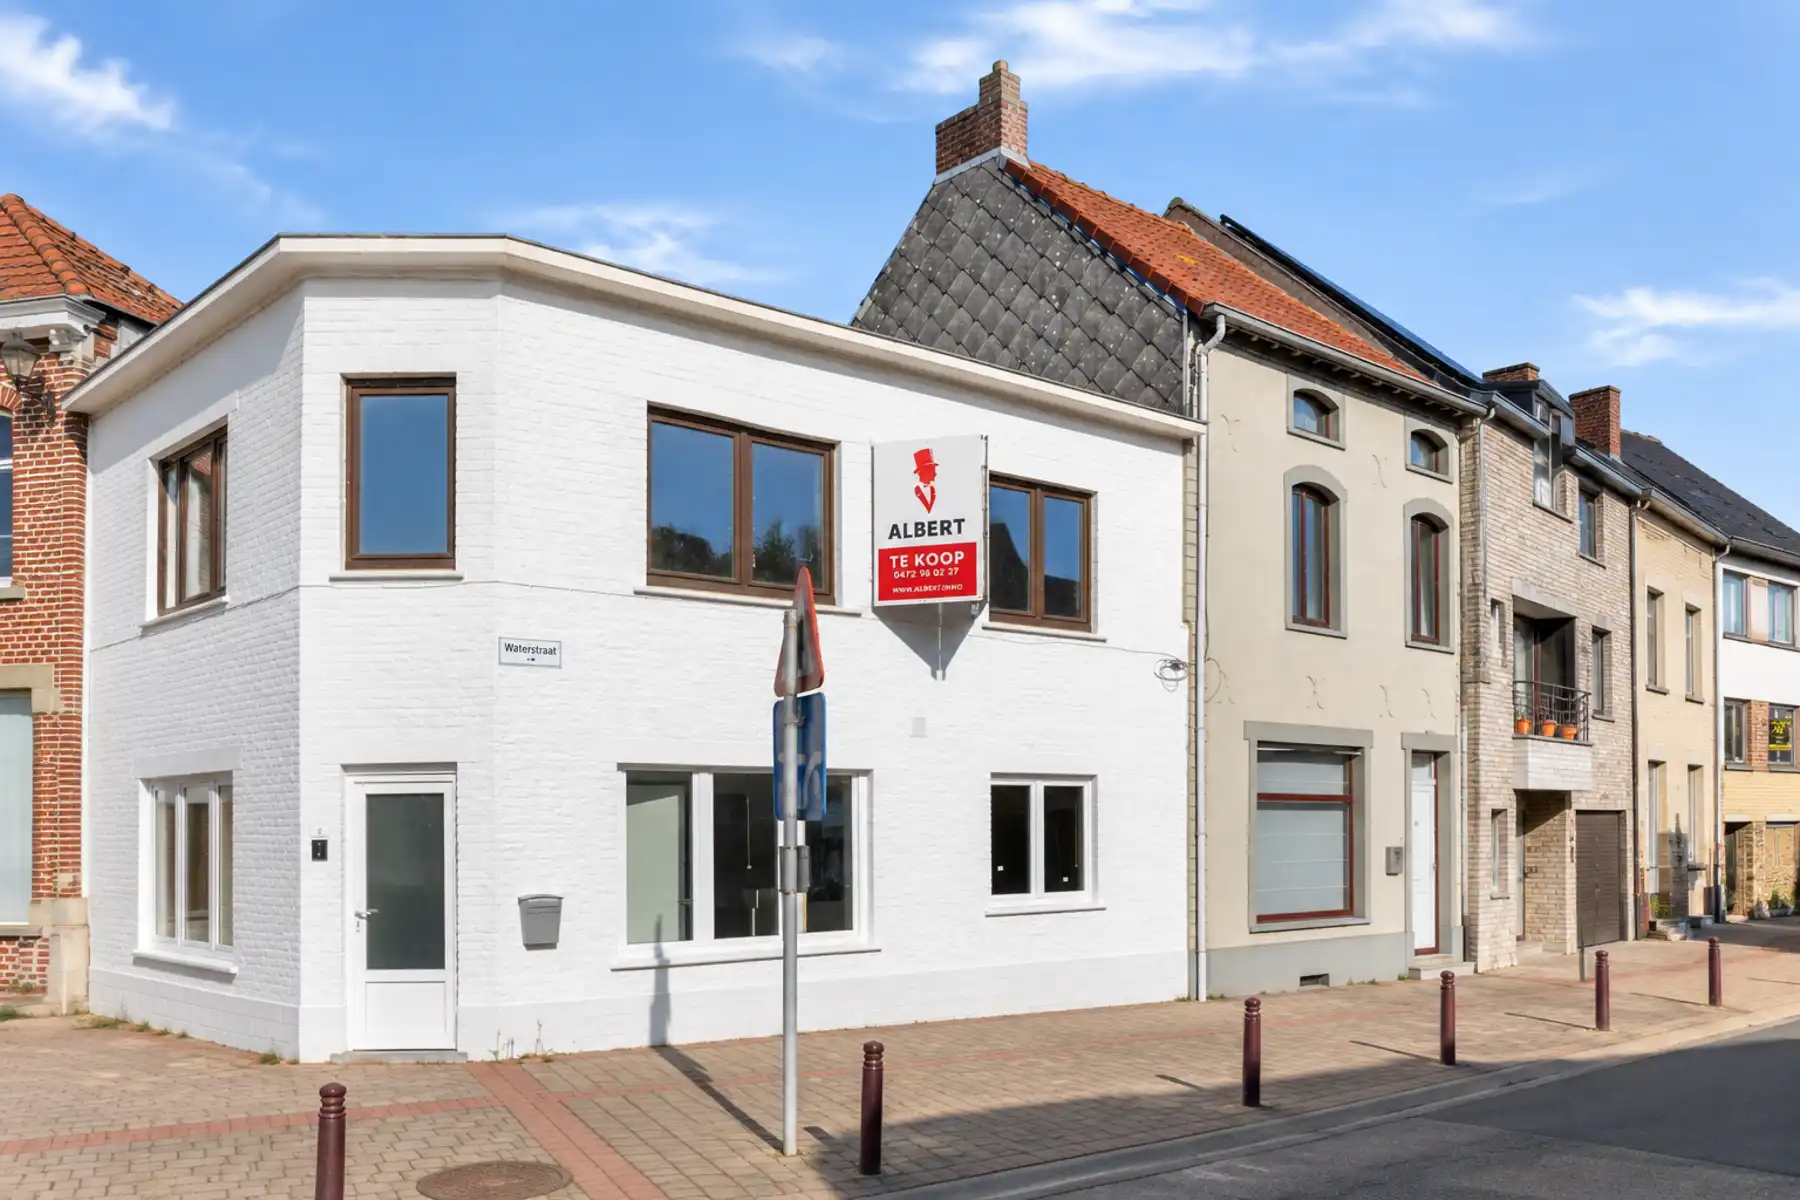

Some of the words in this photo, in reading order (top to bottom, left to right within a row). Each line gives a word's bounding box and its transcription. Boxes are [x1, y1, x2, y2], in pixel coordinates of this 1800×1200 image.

[888, 518, 965, 540] ALBERT
[889, 555, 909, 568] TE
[914, 551, 965, 567] KOOP
[893, 570, 917, 579] 0472
[933, 567, 945, 577] 02
[947, 567, 959, 576] 27
[504, 642, 557, 655] Waterstraat
